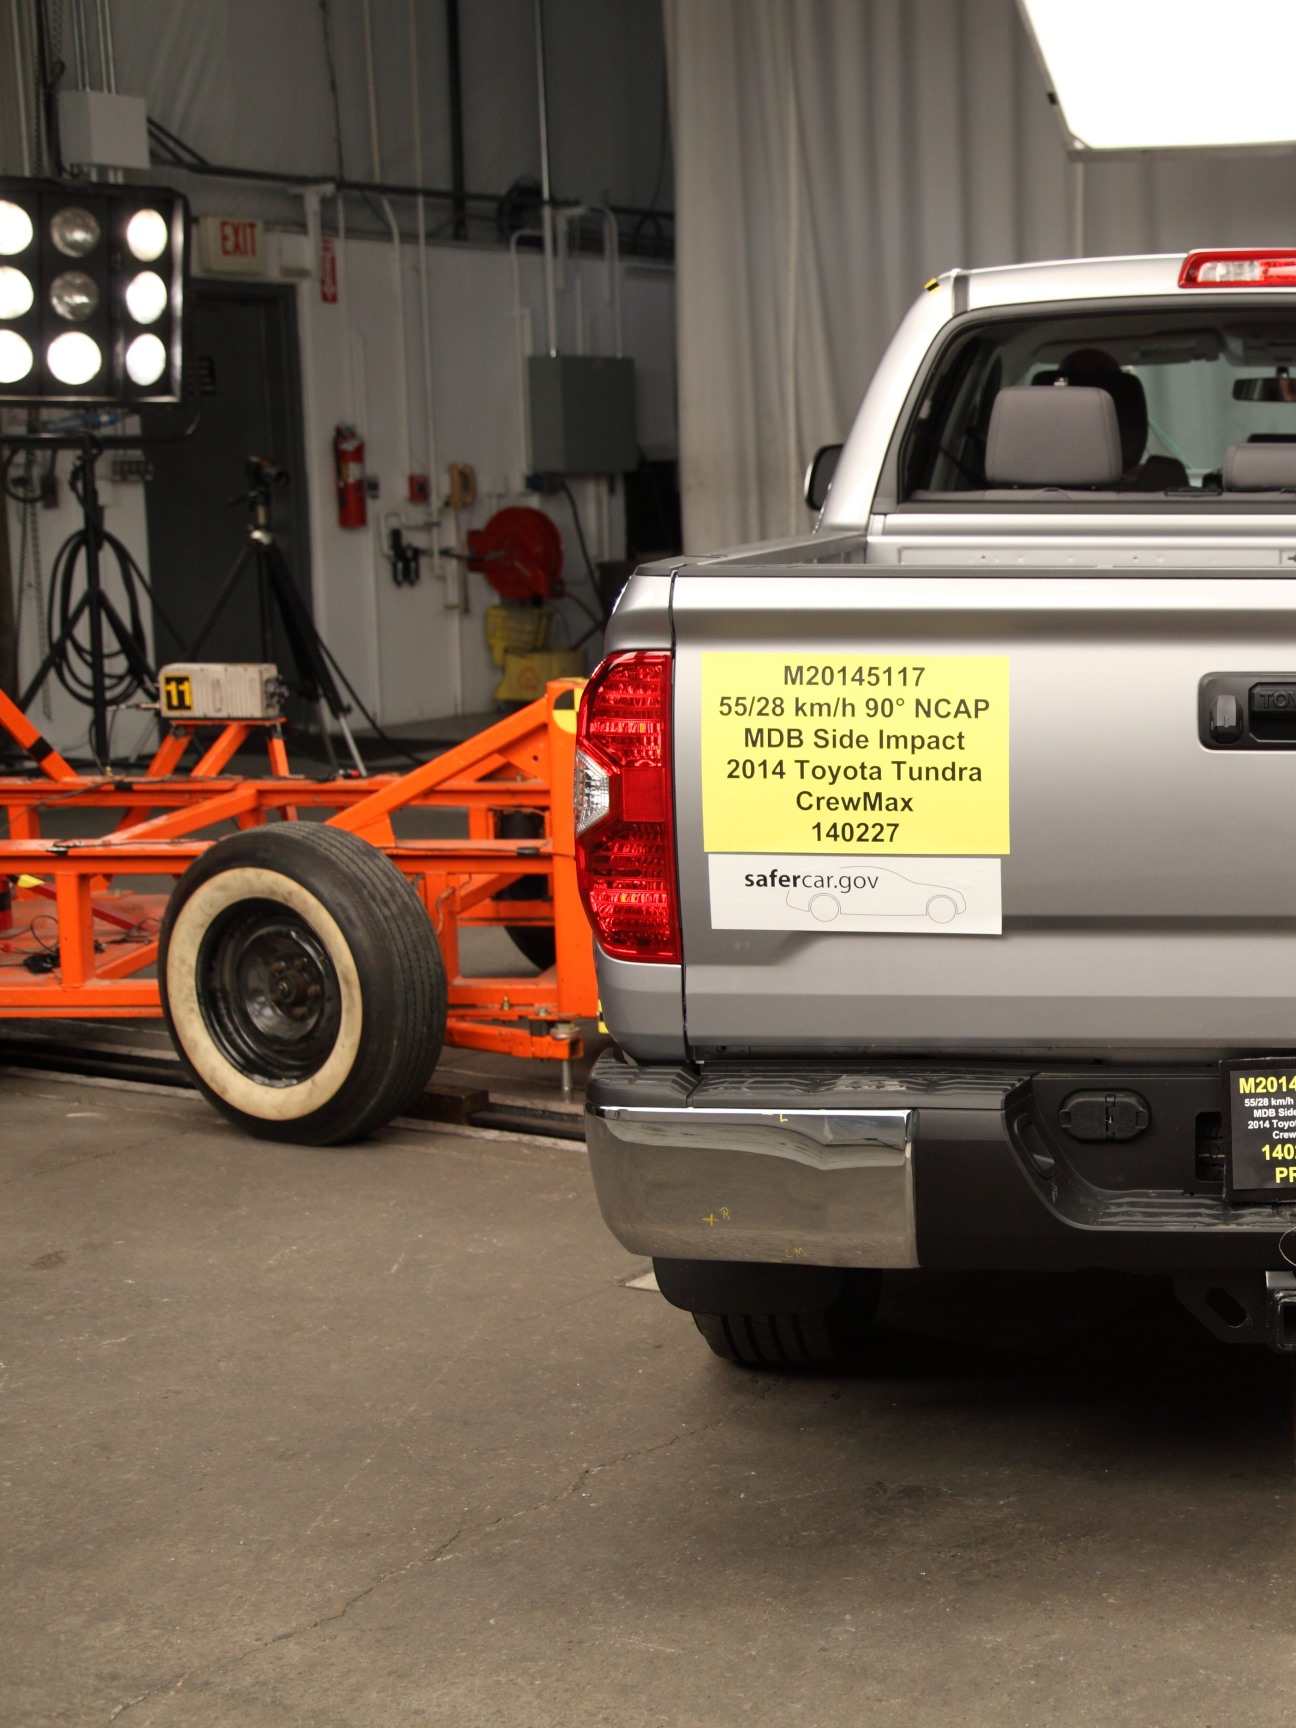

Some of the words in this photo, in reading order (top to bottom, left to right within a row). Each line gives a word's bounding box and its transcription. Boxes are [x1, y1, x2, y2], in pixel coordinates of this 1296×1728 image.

[220, 221, 257, 257] EXIT
[783, 665, 926, 687] M20145117
[165, 680, 191, 707] 11
[719, 696, 785, 717] 55/28
[794, 697, 856, 718] km/h
[915, 698, 990, 719] NCAP
[744, 728, 804, 748] MDB
[813, 728, 869, 749] Side
[879, 729, 965, 754] Impact
[727, 759, 786, 780] 2014
[794, 759, 882, 785] Toyota
[891, 761, 982, 782] Tundra
[796, 791, 914, 812] CrewMax
[812, 823, 899, 842] 140227
[745, 869, 879, 893] safercar.gov
[1244, 1098, 1269, 1107] 55/28
[1271, 1097, 1294, 1106] km/h
[1254, 1109, 1276, 1118] MDB
[1248, 1121, 1270, 1129] 2014
